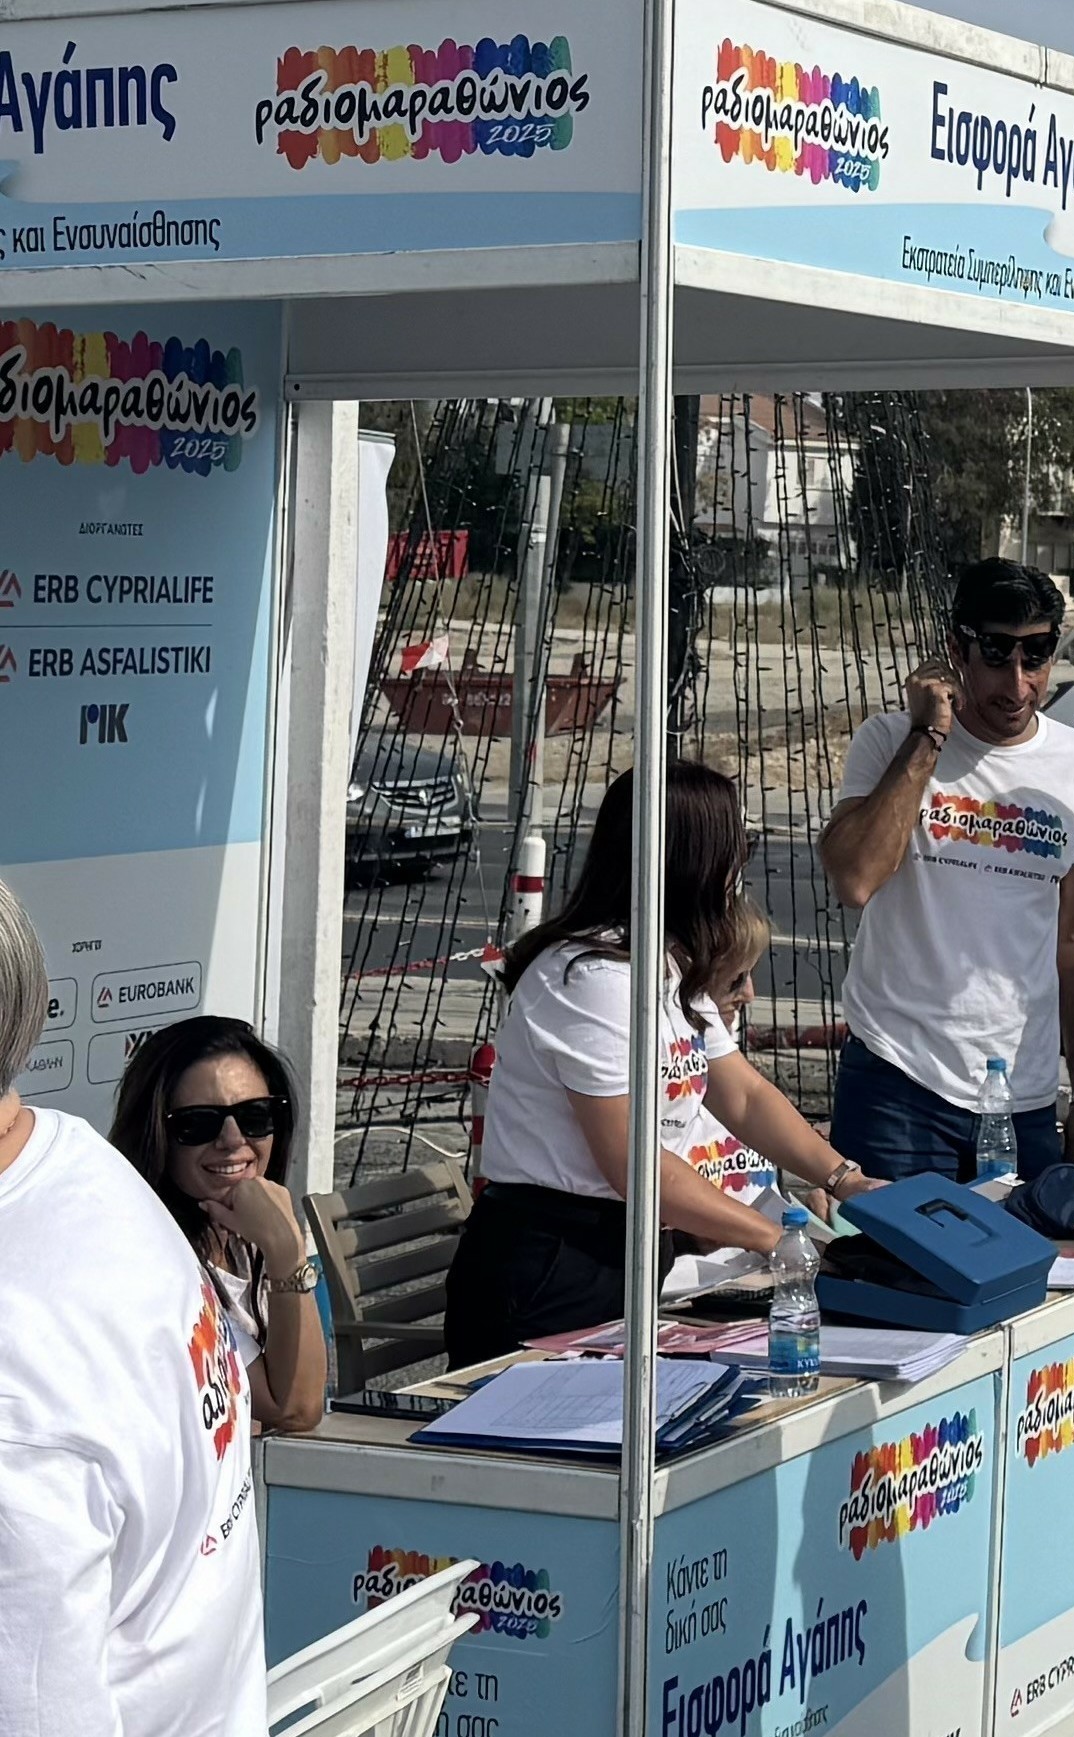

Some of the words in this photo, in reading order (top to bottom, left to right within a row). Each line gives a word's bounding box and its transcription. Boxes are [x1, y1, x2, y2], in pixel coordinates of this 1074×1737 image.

[0, 41, 177, 154] Αγάπης
[256, 73, 590, 145] ραδιομαραθώνιος
[702, 73, 889, 159] ραδιομαραθώνιος
[486, 123, 555, 145] 2025
[931, 80, 1036, 198] Εισφορά
[834, 157, 872, 180] 2025
[13, 226, 46, 253] και
[53, 210, 221, 252] Ενσυναίσθησης
[902, 235, 966, 282] Εκστρατεία
[1045, 272, 1061, 296] και
[0, 352, 257, 438] διομαραθώνιος
[170, 437, 229, 460] 2025
[33, 574, 79, 604] ERB
[86, 574, 214, 604] CYPRIALIFE
[29, 647, 74, 677] ERB
[79, 646, 212, 676] ASFALISTIKI
[919, 806, 1068, 846] ραδιομαραθώνιος
[118, 976, 195, 1004] EUROBANK
[839, 1435, 983, 1545] ραδιομαραθώνιος
[666, 1554, 709, 1604] Κάντε
[713, 1548, 728, 1580] τη
[665, 1599, 697, 1655] δική
[701, 1597, 728, 1636] σας
[662, 1623, 772, 1737] Εισφορά
[779, 1597, 868, 1705] Αγάπης
[1026, 1673, 1046, 1705] ERB
